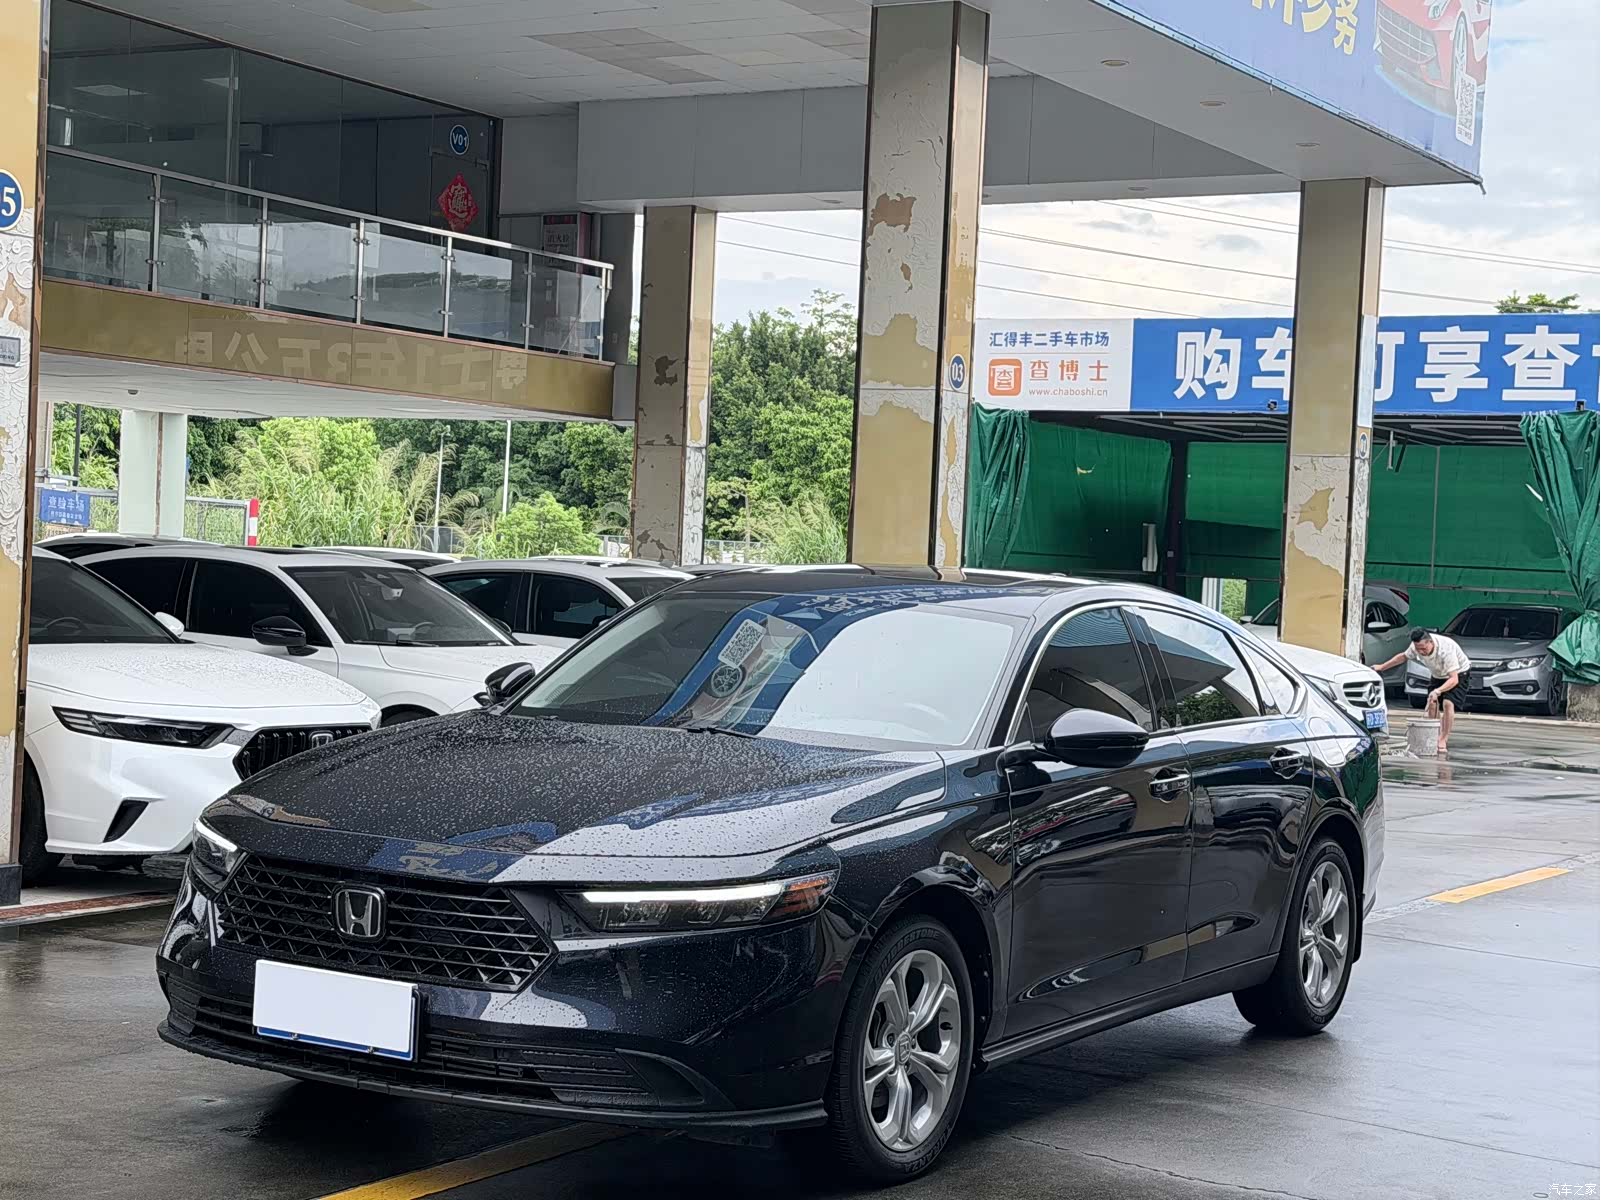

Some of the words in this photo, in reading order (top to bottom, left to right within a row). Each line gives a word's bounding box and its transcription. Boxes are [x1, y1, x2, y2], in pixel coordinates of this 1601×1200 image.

[452, 132, 469, 147] V01
[988, 331, 1110, 348] 汇得丰二手车市场
[951, 363, 964, 382] 03
[1029, 359, 1109, 381] 查博士
[1173, 325, 1600, 403] 购车享查
[1028, 387, 1108, 397] www.chaboshi.cn
